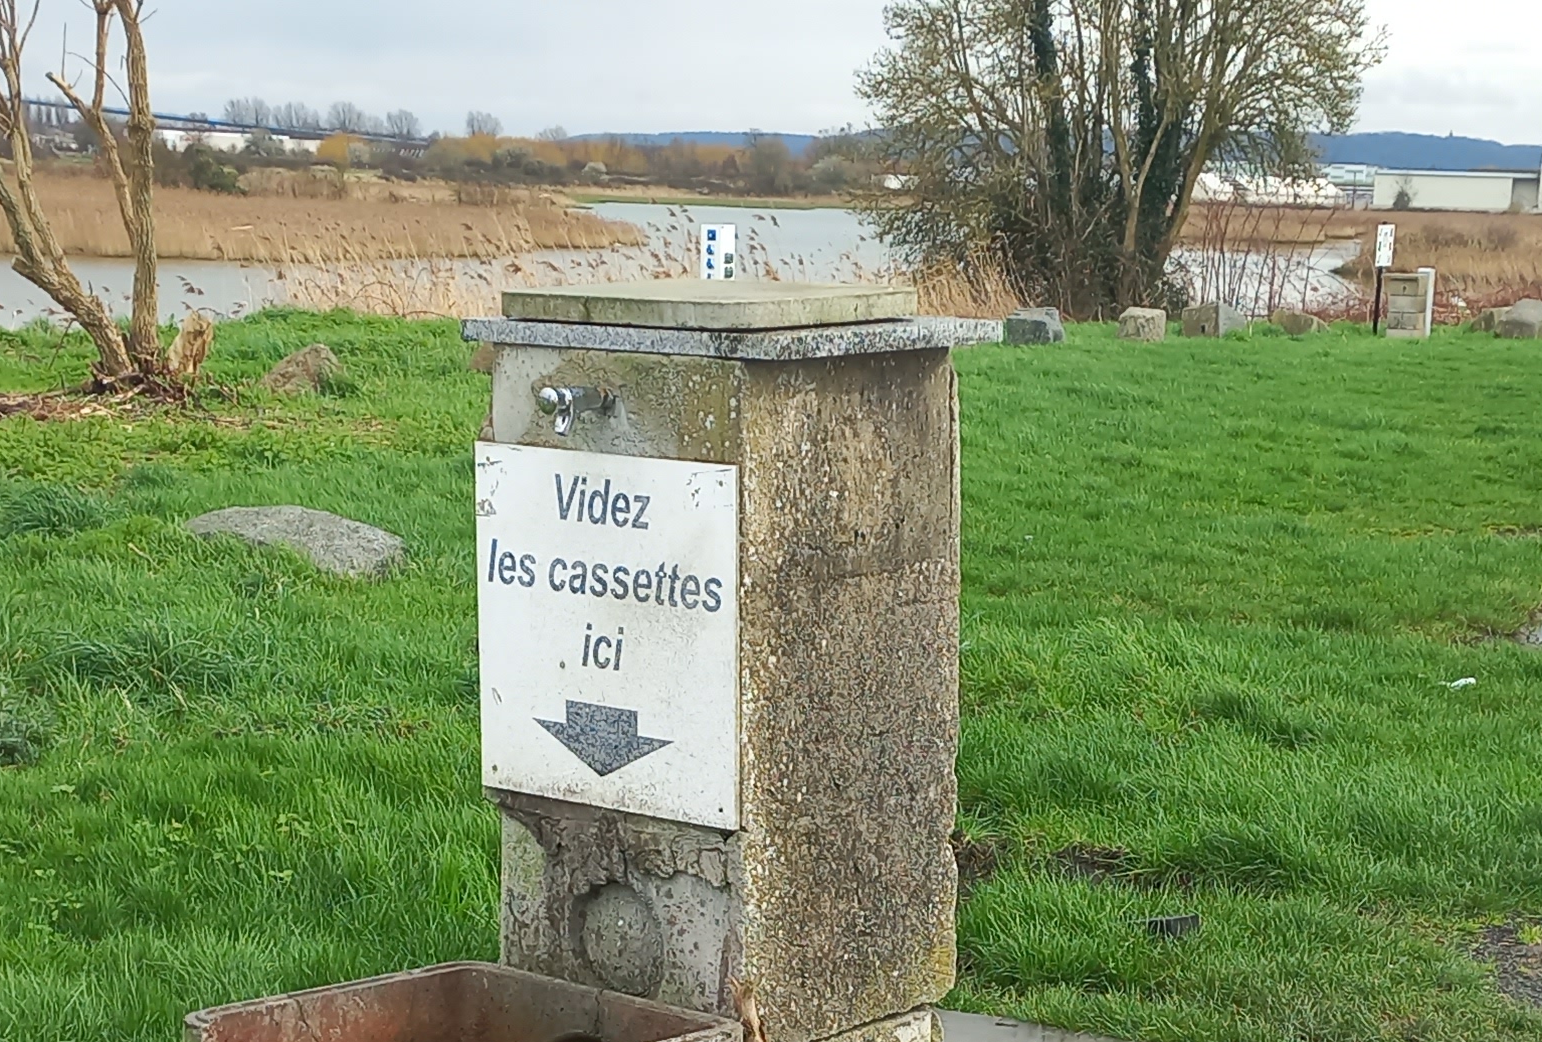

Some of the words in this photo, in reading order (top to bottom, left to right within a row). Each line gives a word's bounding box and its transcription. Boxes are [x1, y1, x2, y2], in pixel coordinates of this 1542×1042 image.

[555, 473, 650, 530] Videz
[488, 538, 536, 588] les
[548, 558, 723, 613] cassettes
[581, 623, 624, 671] ici
